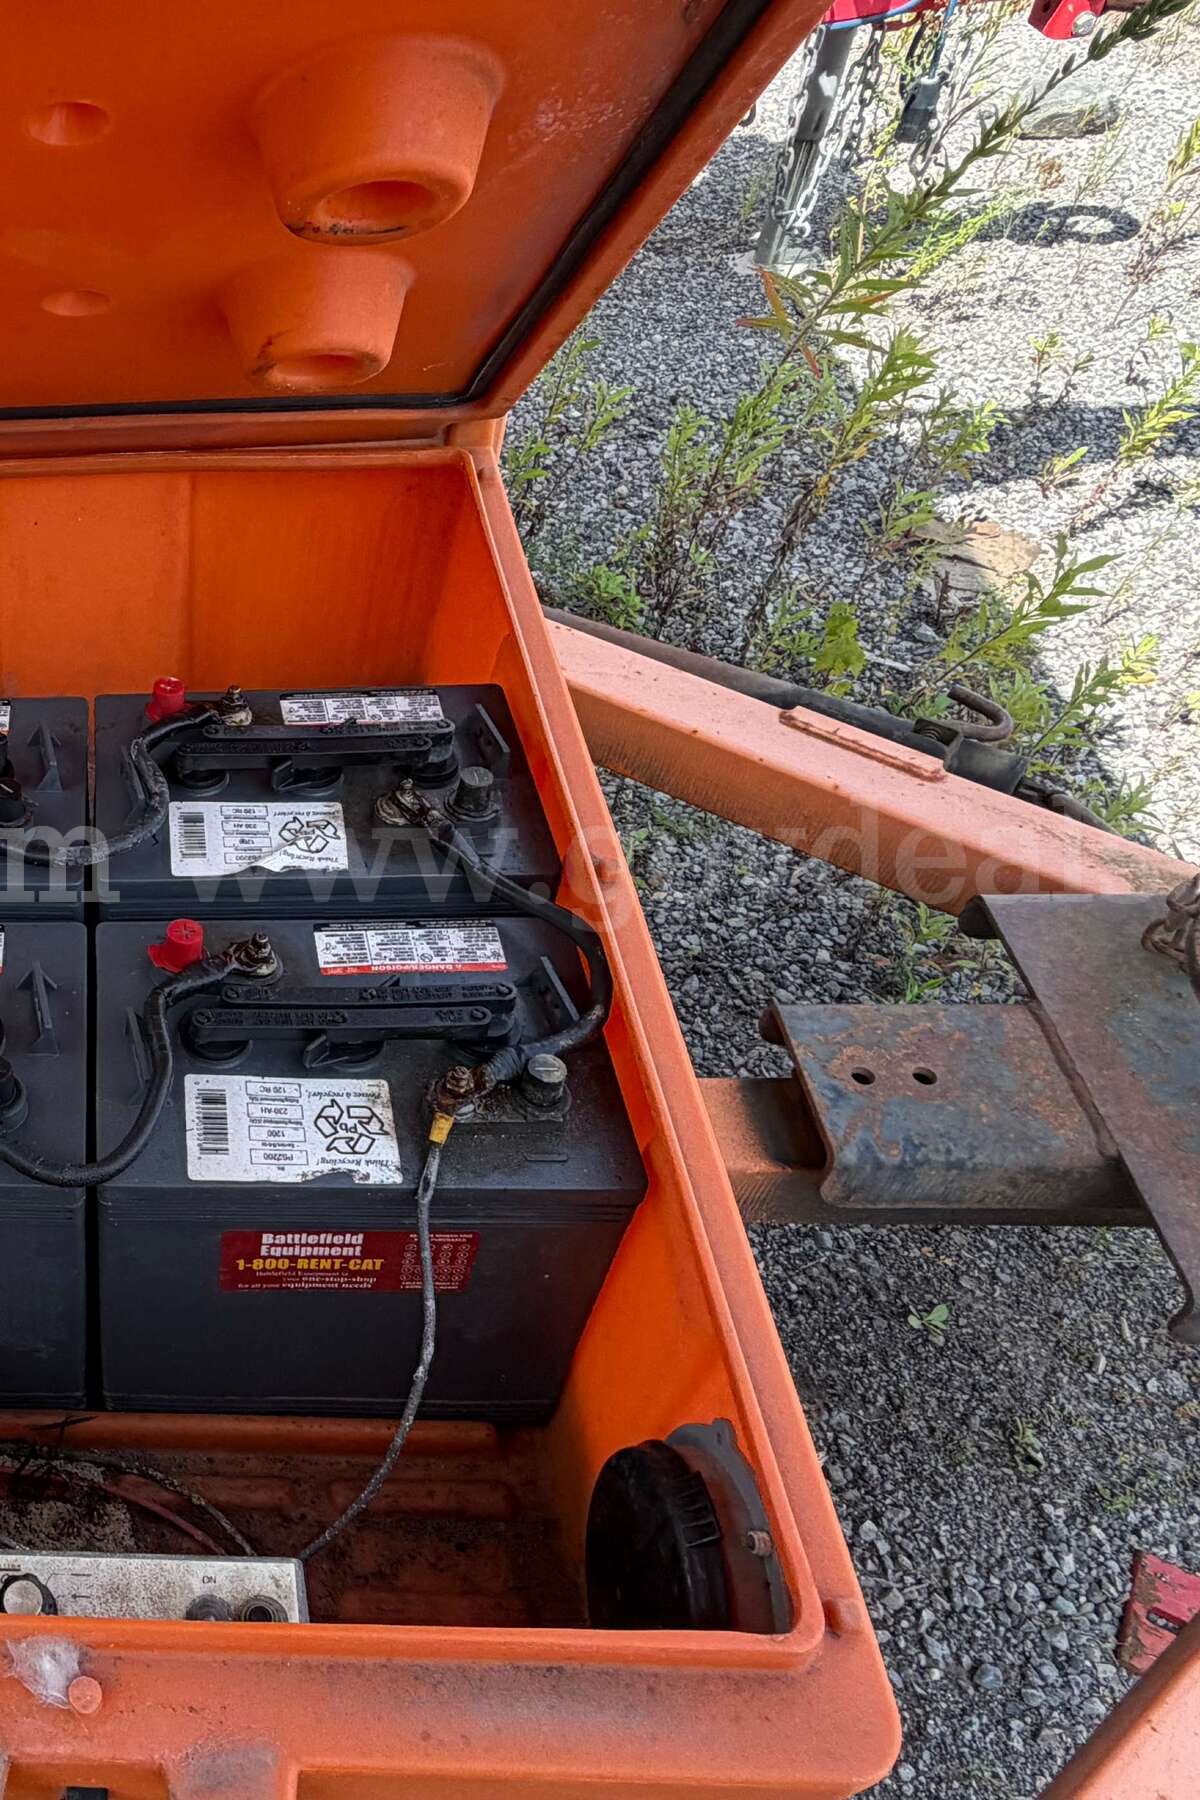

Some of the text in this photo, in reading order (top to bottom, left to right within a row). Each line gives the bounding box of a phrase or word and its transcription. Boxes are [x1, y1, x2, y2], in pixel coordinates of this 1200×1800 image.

[259, 1085, 271, 1093] RC
[307, 1091, 344, 1100] recycler!
[339, 1122, 357, 1133] Pb
[263, 1152, 293, 1161] PS2200
[316, 1156, 389, 1167] Think Recycling!
[262, 1233, 364, 1245] Battlefield
[260, 1245, 362, 1257] Equipment
[235, 1258, 385, 1271] 1-800-RENT-CAT
[202, 1575, 217, 1584] ON
